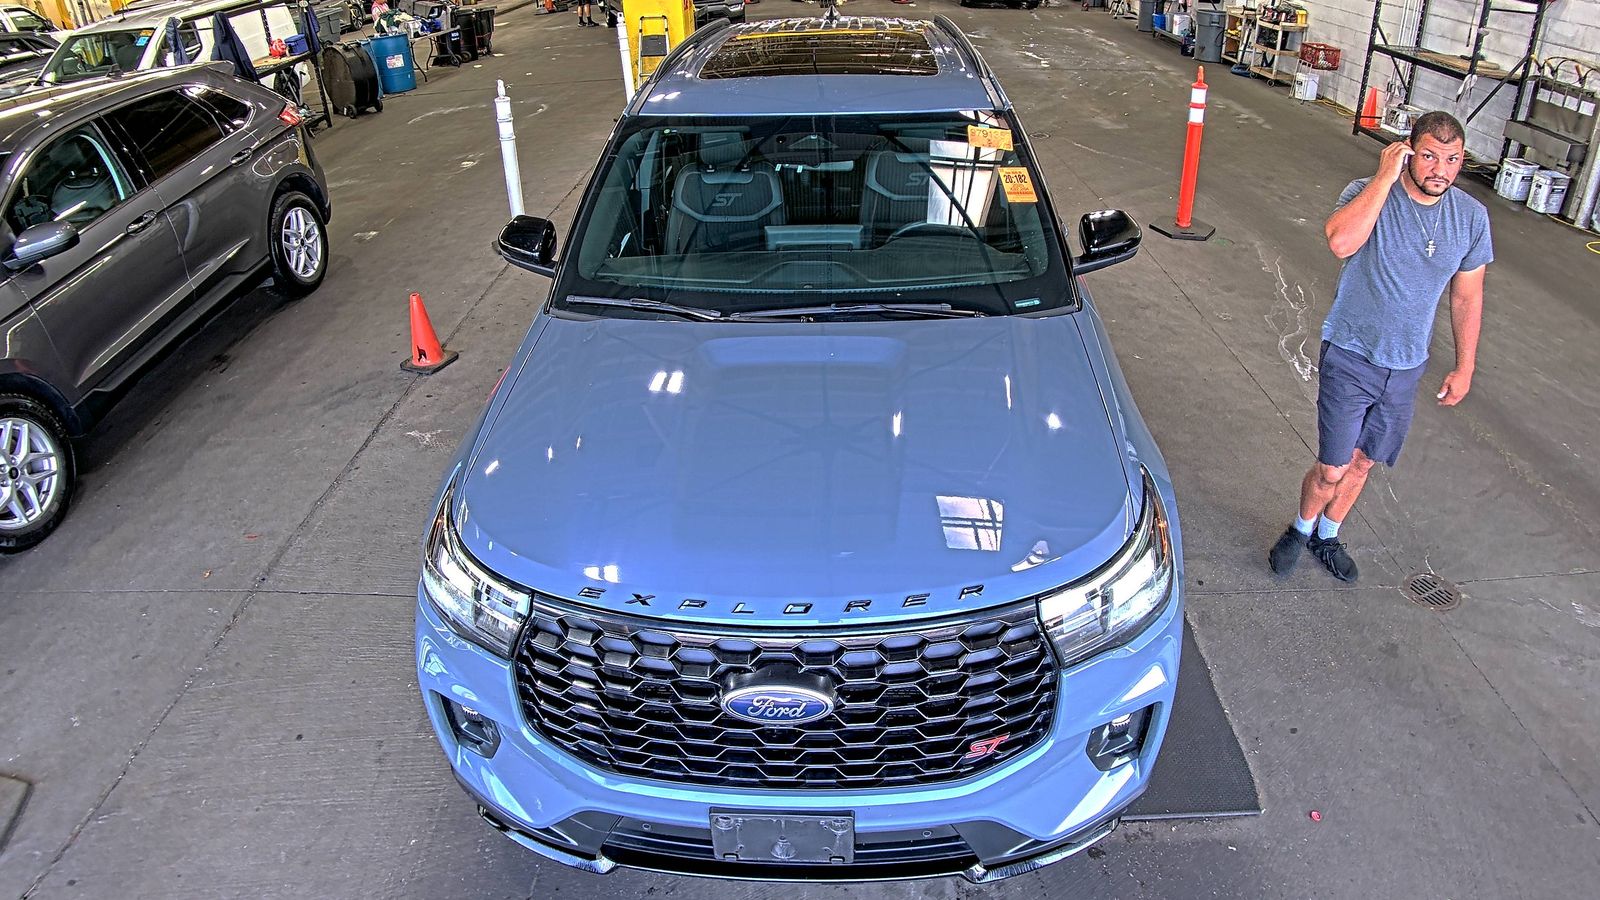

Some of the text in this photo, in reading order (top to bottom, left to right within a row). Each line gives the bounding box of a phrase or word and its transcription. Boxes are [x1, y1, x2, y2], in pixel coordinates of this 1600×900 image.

[712, 192, 743, 207] ST
[577, 583, 985, 616] EXPLORER
[747, 695, 807, 718] Ford
[965, 733, 1010, 758] ST
